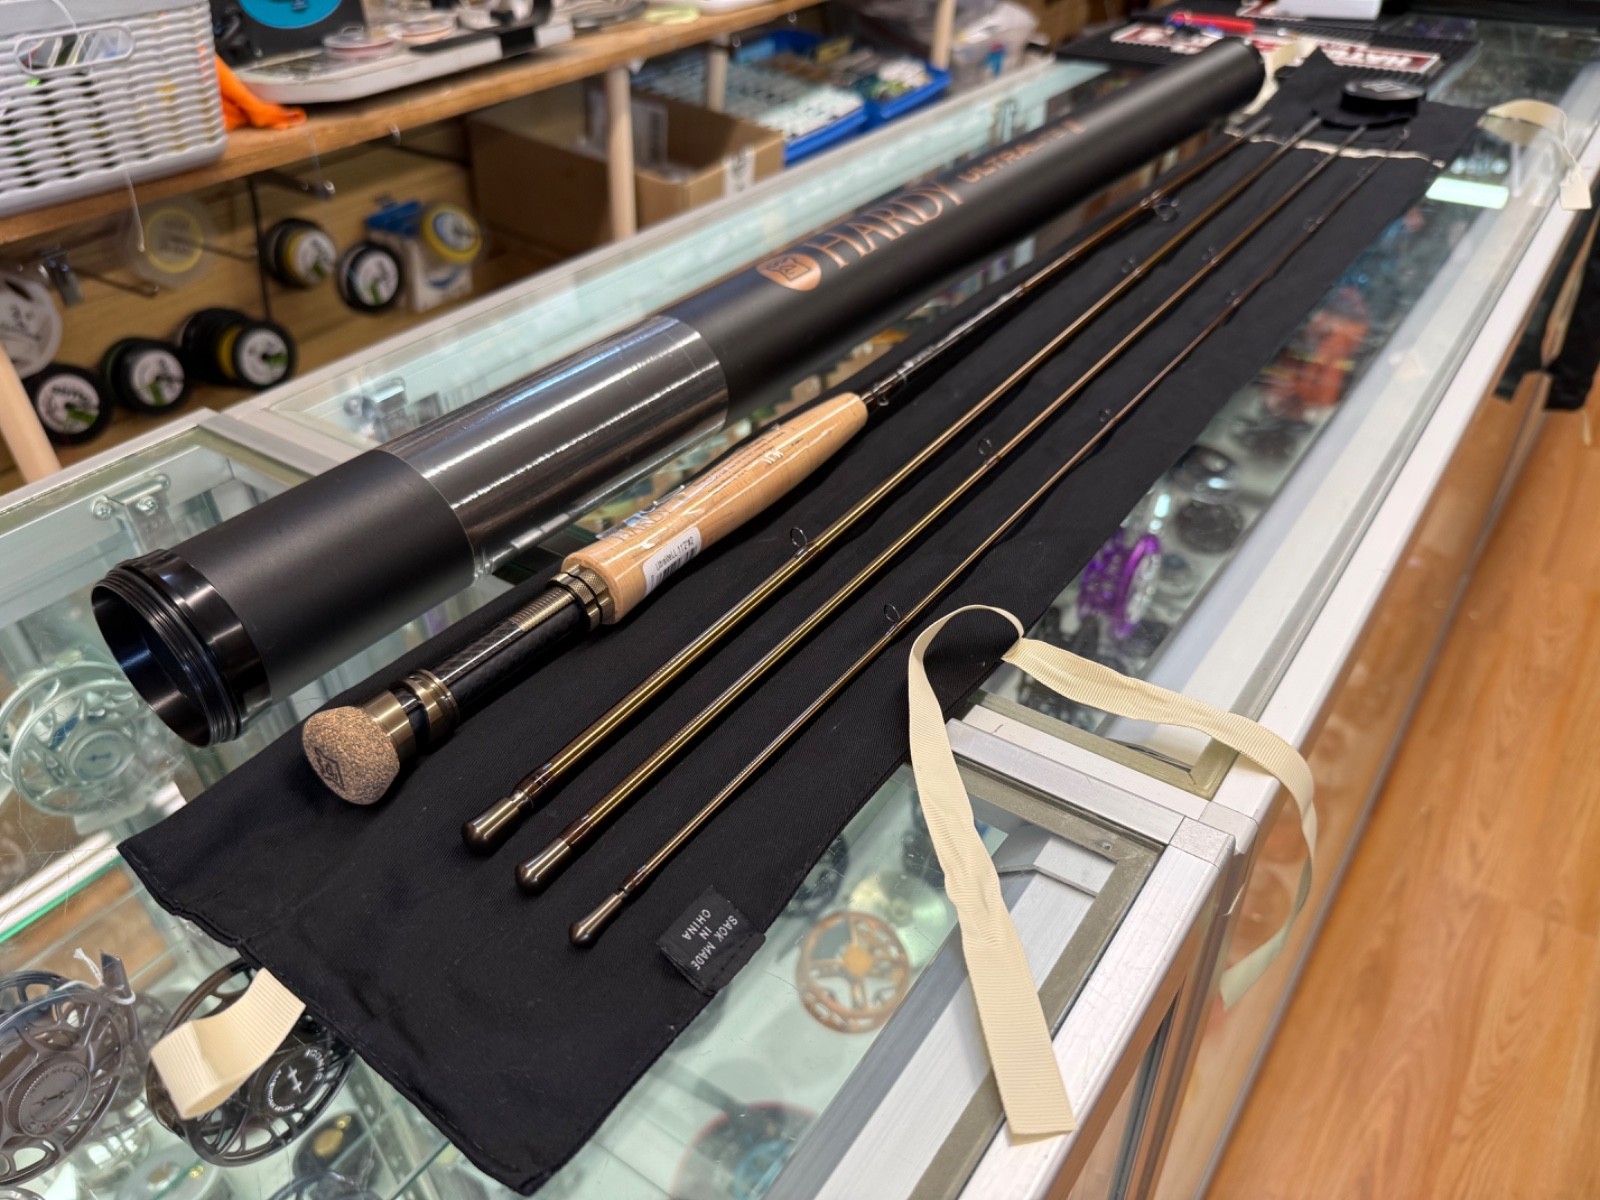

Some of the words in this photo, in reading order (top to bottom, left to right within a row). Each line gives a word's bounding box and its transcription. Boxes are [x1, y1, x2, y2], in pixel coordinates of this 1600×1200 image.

[804, 182, 963, 269] HARDY
[681, 908, 712, 940] CHINA
[698, 926, 713, 940] IN
[713, 914, 738, 943] SACK
[690, 941, 717, 971] MADE
